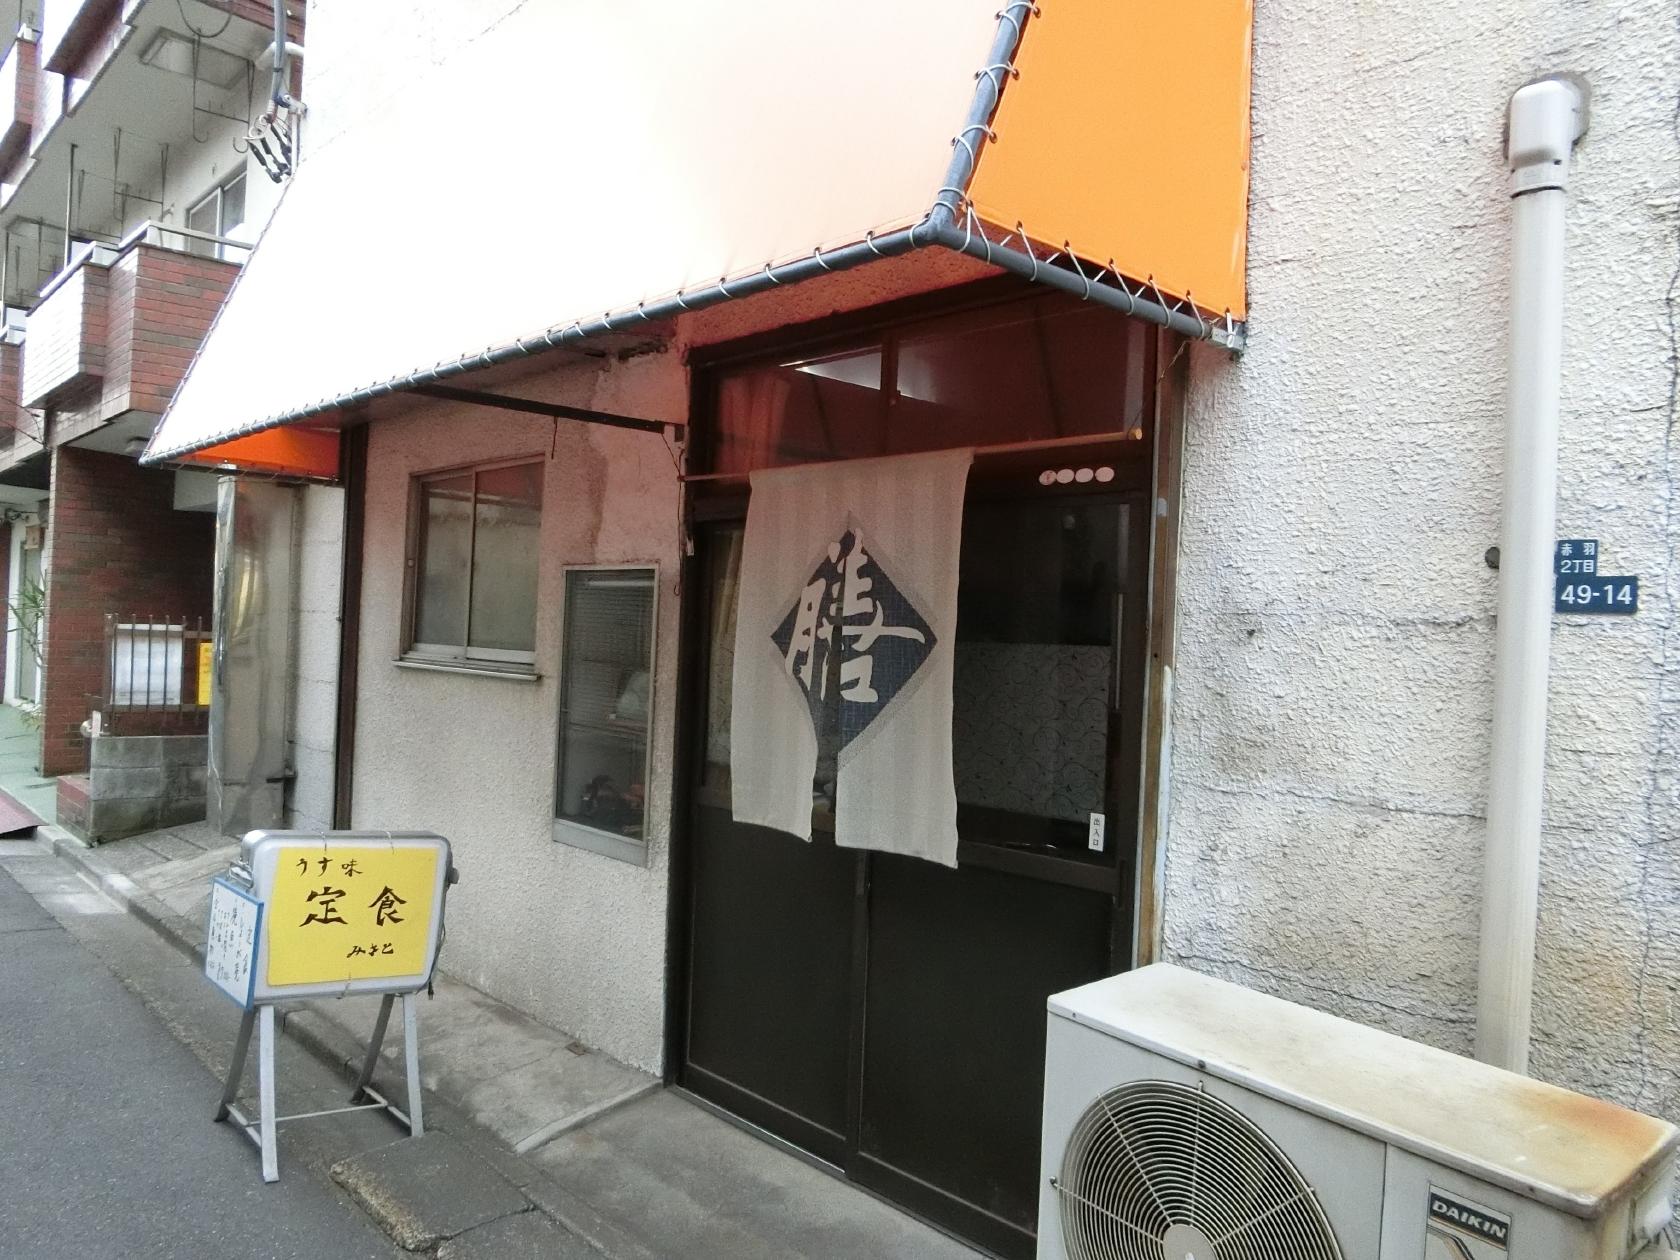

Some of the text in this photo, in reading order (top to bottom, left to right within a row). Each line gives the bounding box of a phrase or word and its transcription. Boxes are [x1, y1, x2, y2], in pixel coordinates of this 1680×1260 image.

[1560, 542, 1596, 556] 赤羽
[1560, 559, 1595, 573] 2丁目
[1560, 584, 1633, 605] 49-14
[295, 856, 364, 878] うす味
[298, 885, 409, 927] 定食
[1431, 1200, 1507, 1239] DAIKIN
